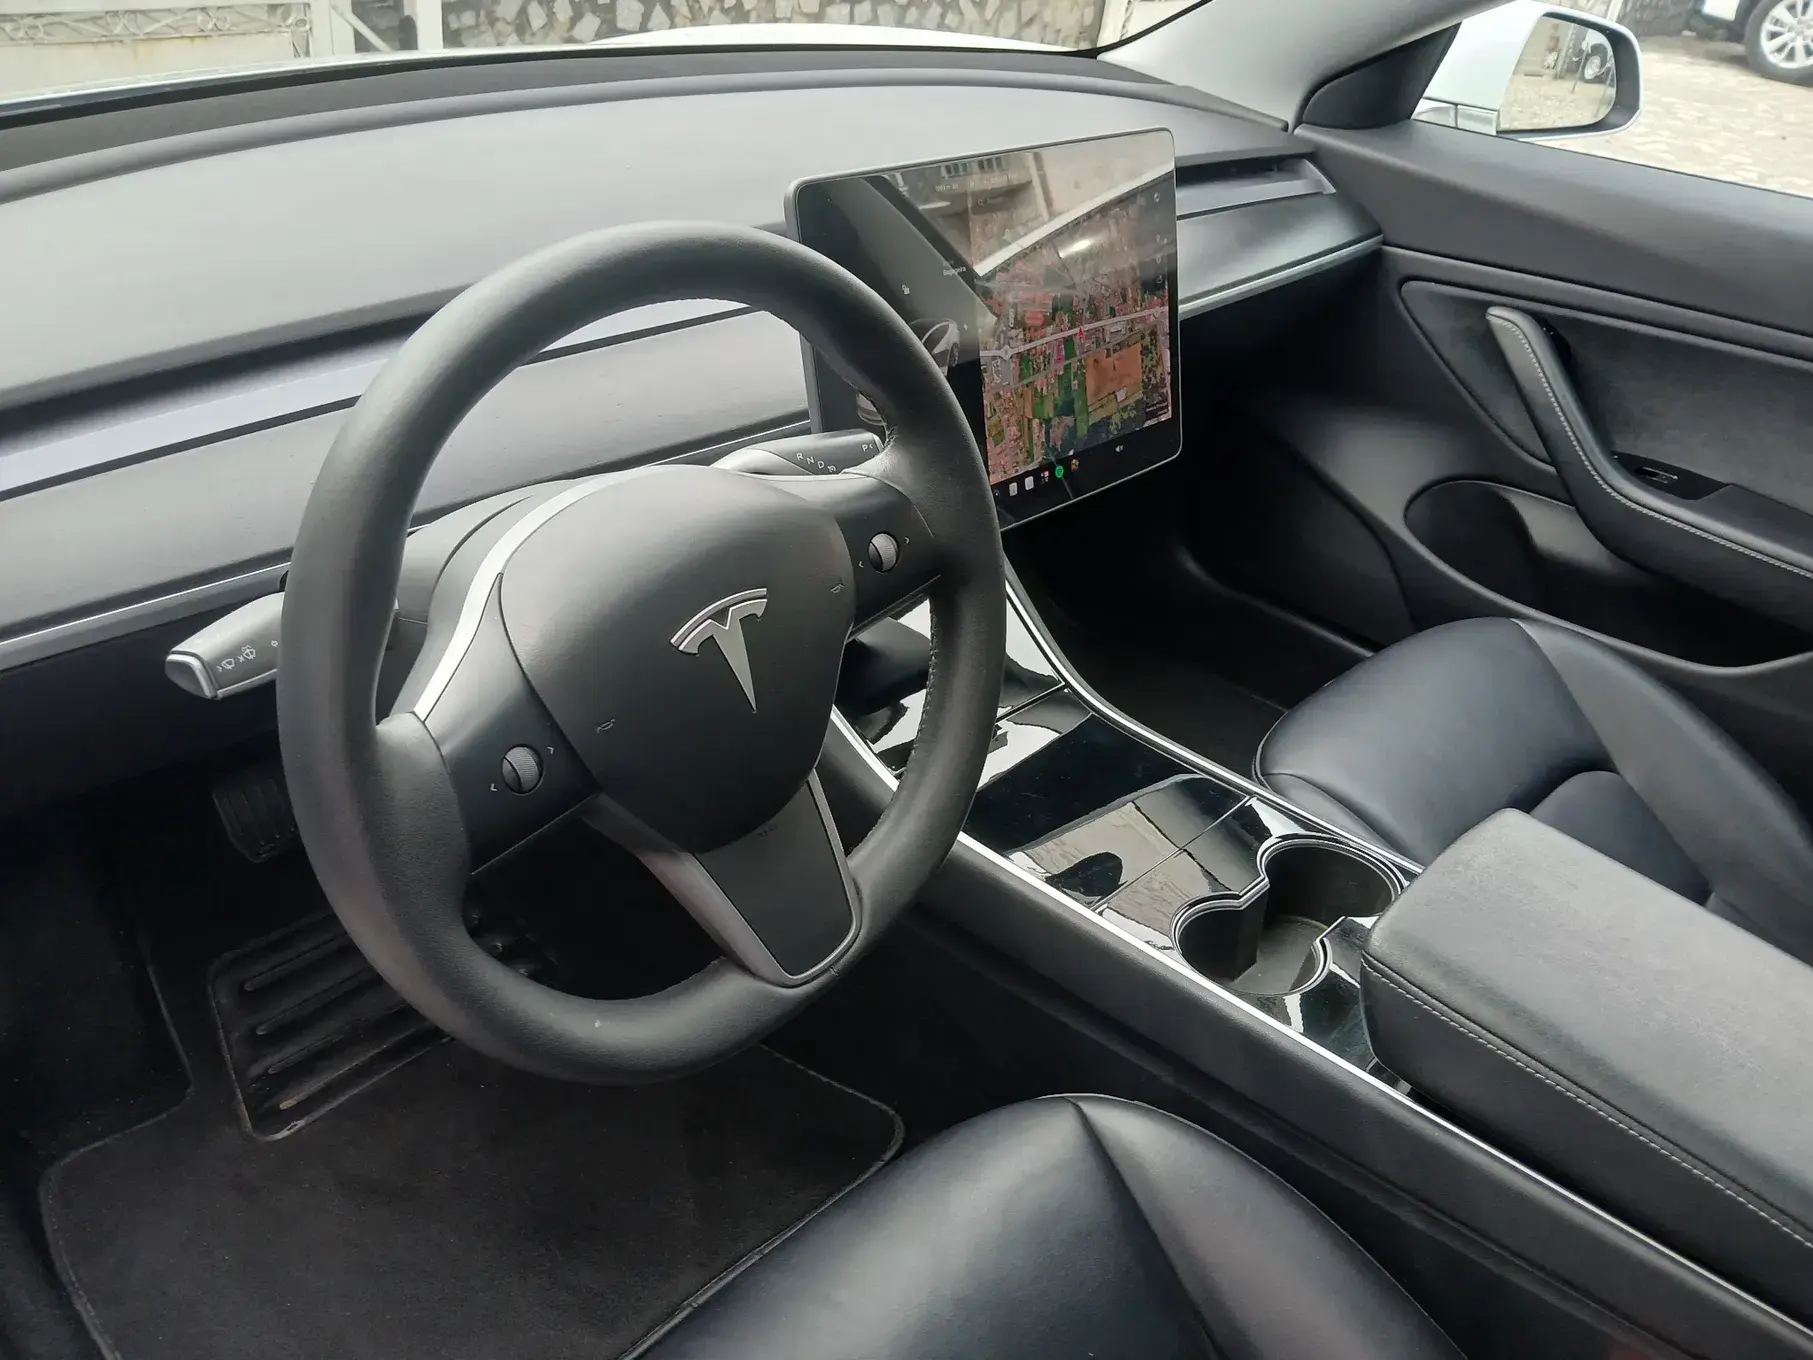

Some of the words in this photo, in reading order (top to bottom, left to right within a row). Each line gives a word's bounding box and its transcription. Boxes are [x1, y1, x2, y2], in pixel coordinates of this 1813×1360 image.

[861, 444, 868, 452] P
[806, 457, 815, 465] N
[817, 461, 825, 469] D
